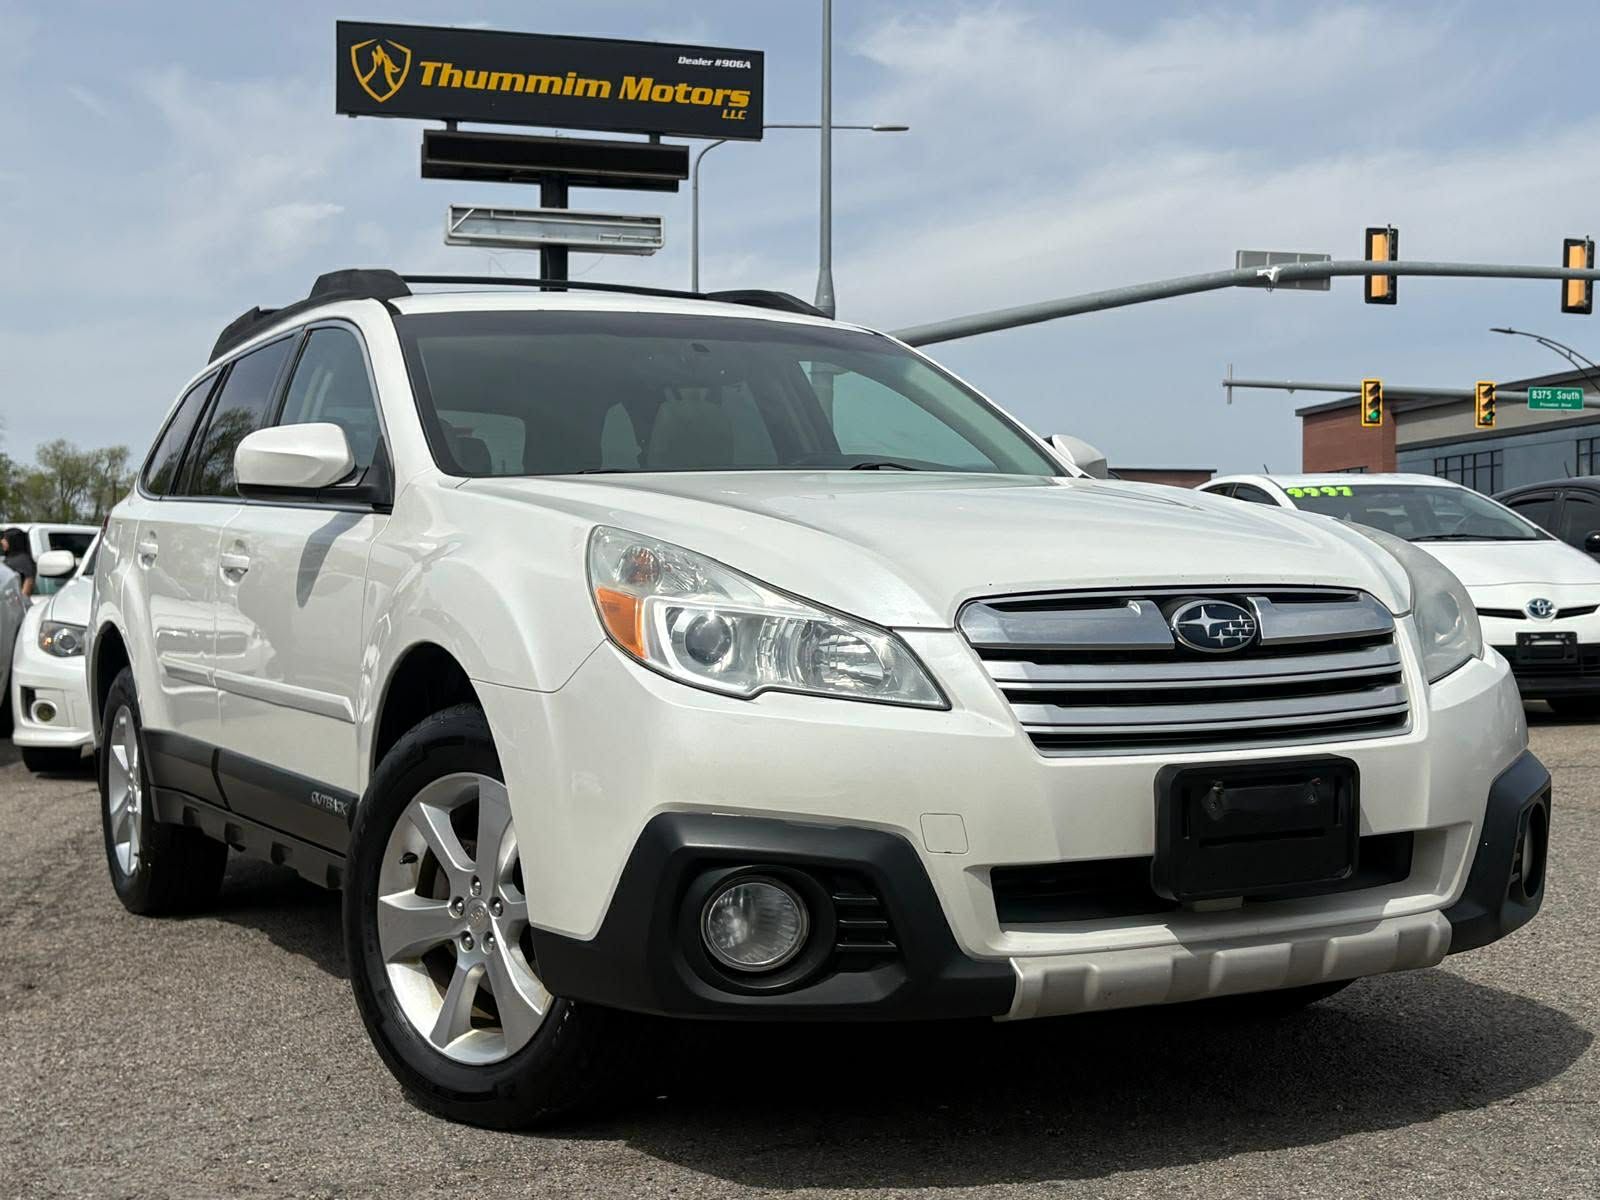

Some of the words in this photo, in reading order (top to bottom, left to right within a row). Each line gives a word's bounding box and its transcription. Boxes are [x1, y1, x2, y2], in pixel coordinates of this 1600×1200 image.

[678, 56, 713, 66] Dealer
[714, 59, 751, 69] #906A
[419, 61, 612, 98] Thummim
[619, 76, 751, 107] Motors
[721, 109, 747, 120] LLC
[1532, 390, 1552, 400] 8375
[1556, 390, 1580, 400] South
[1286, 486, 1353, 498] 9997
